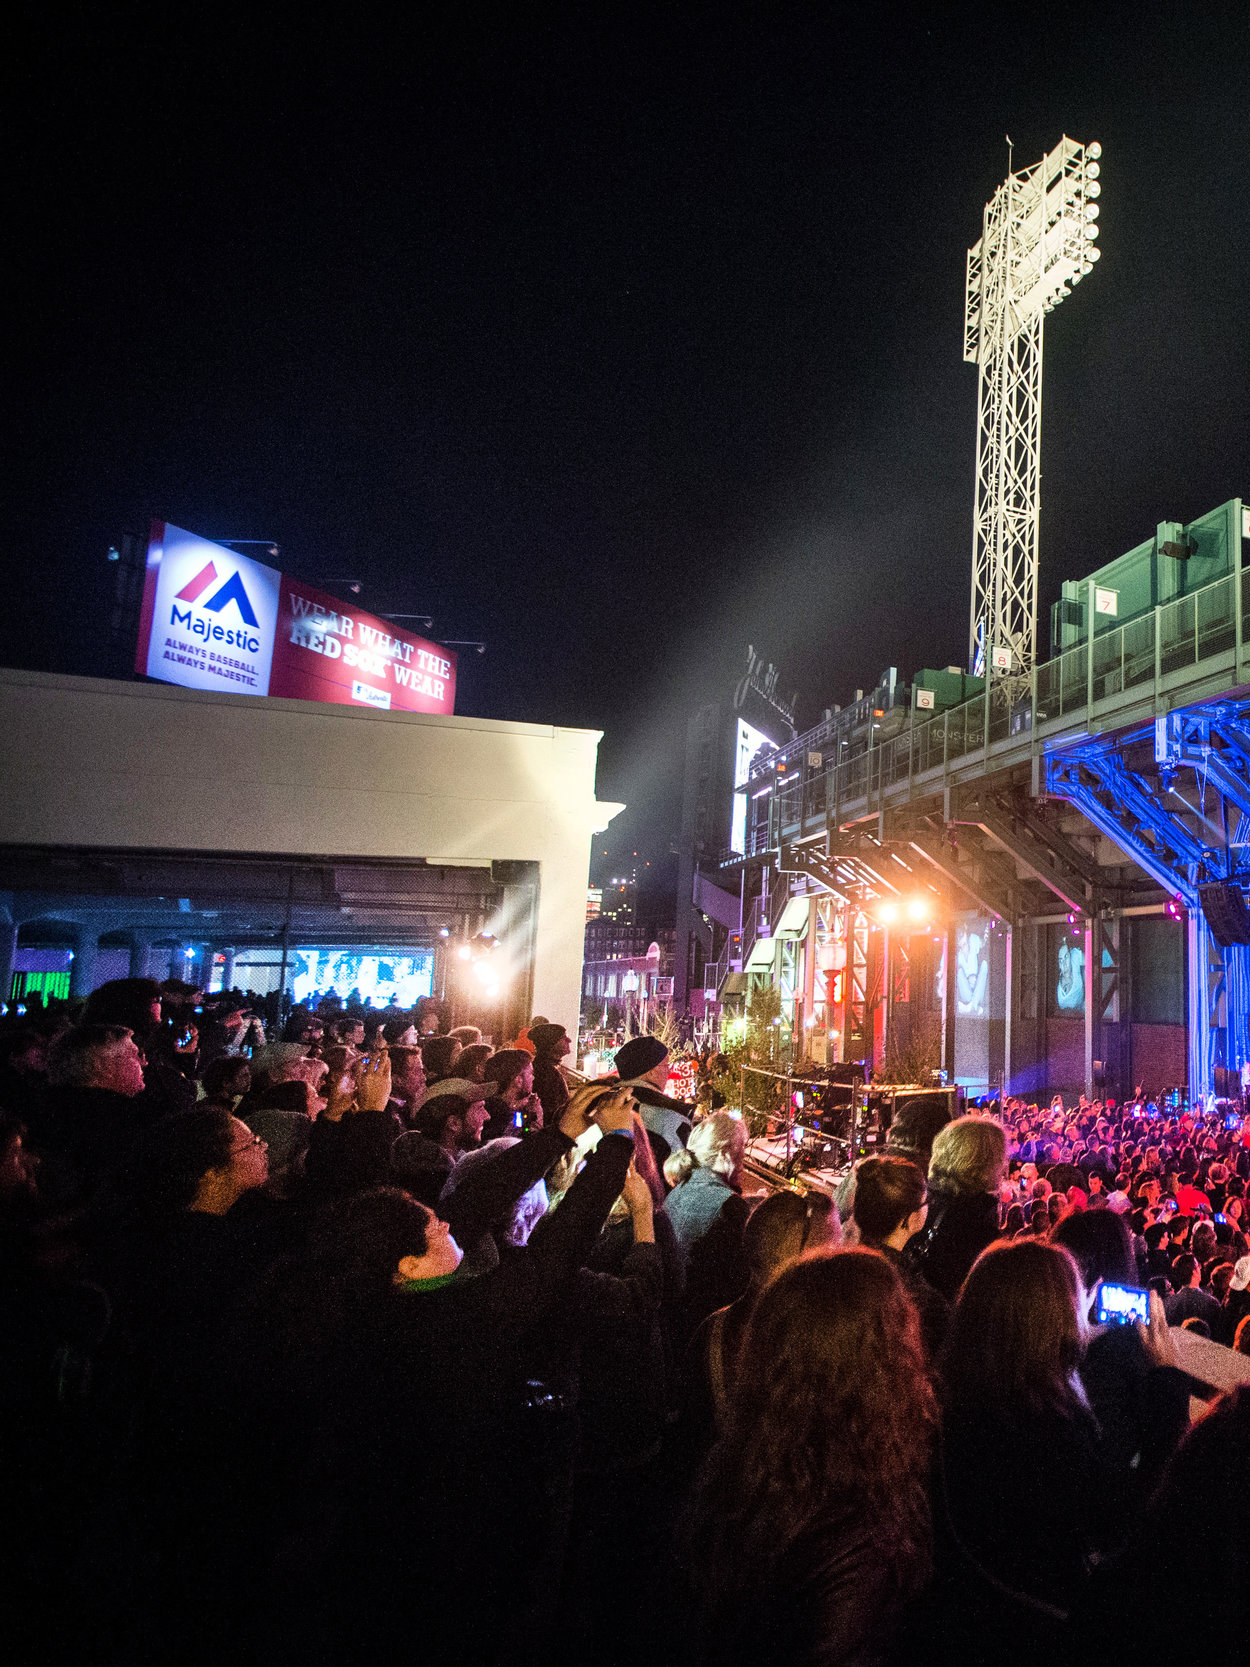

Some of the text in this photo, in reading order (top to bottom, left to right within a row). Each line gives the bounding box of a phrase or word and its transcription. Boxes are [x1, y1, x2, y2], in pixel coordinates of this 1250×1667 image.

[1102, 600, 1110, 611] 7
[170, 604, 260, 653] Majestic
[290, 593, 450, 680] WEAR WHAT THE
[163, 650, 258, 688] ALWAYS MAJESTIC.
[164, 638, 259, 676] ALWAYS BASEBALL.
[290, 621, 342, 659] RED
[342, 643, 392, 679] SOX
[393, 663, 445, 701] WEAR
[998, 656, 1007, 666] 8
[921, 698, 930, 706] 9
[673, 1078, 695, 1088] HOT
